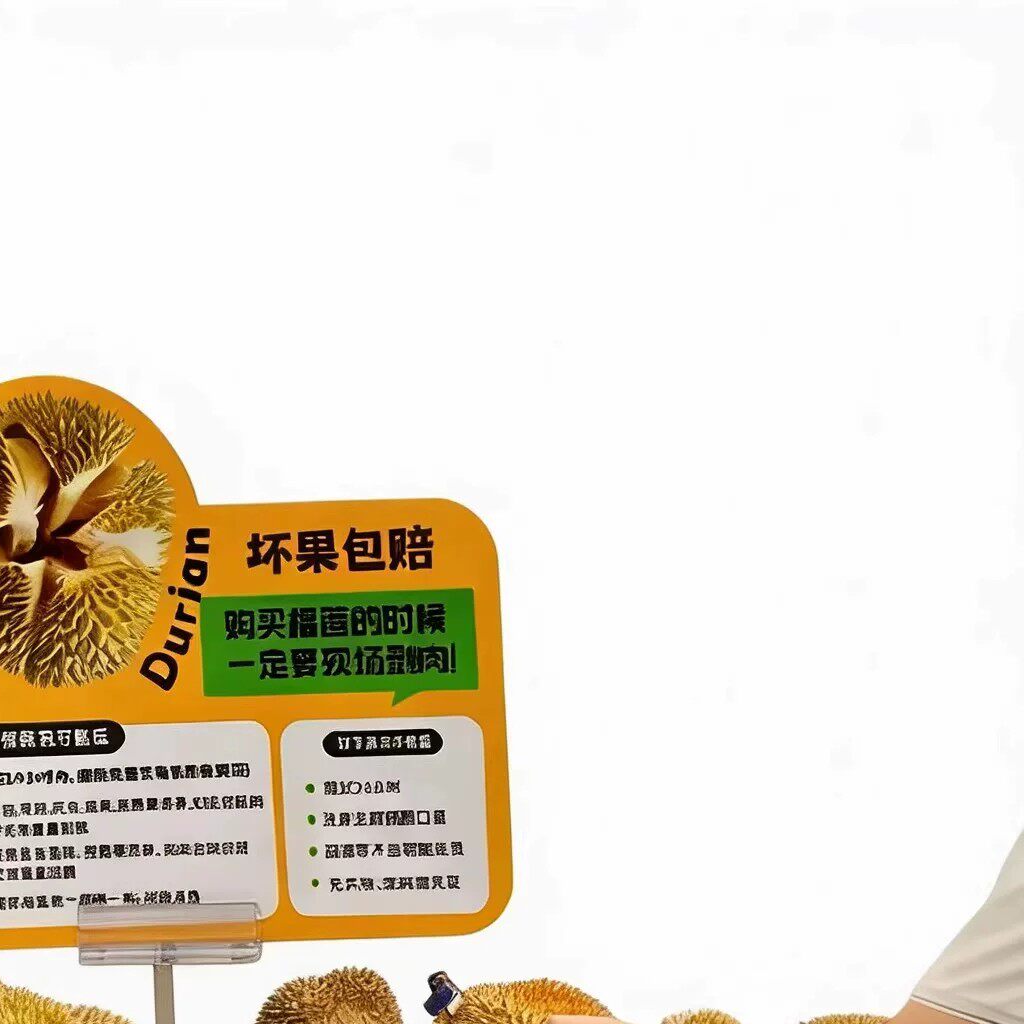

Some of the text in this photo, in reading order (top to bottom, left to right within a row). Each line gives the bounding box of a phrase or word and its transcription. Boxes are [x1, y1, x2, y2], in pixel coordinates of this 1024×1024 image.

[246, 524, 435, 575] 坏果包赔
[139, 527, 211, 692] Durian
